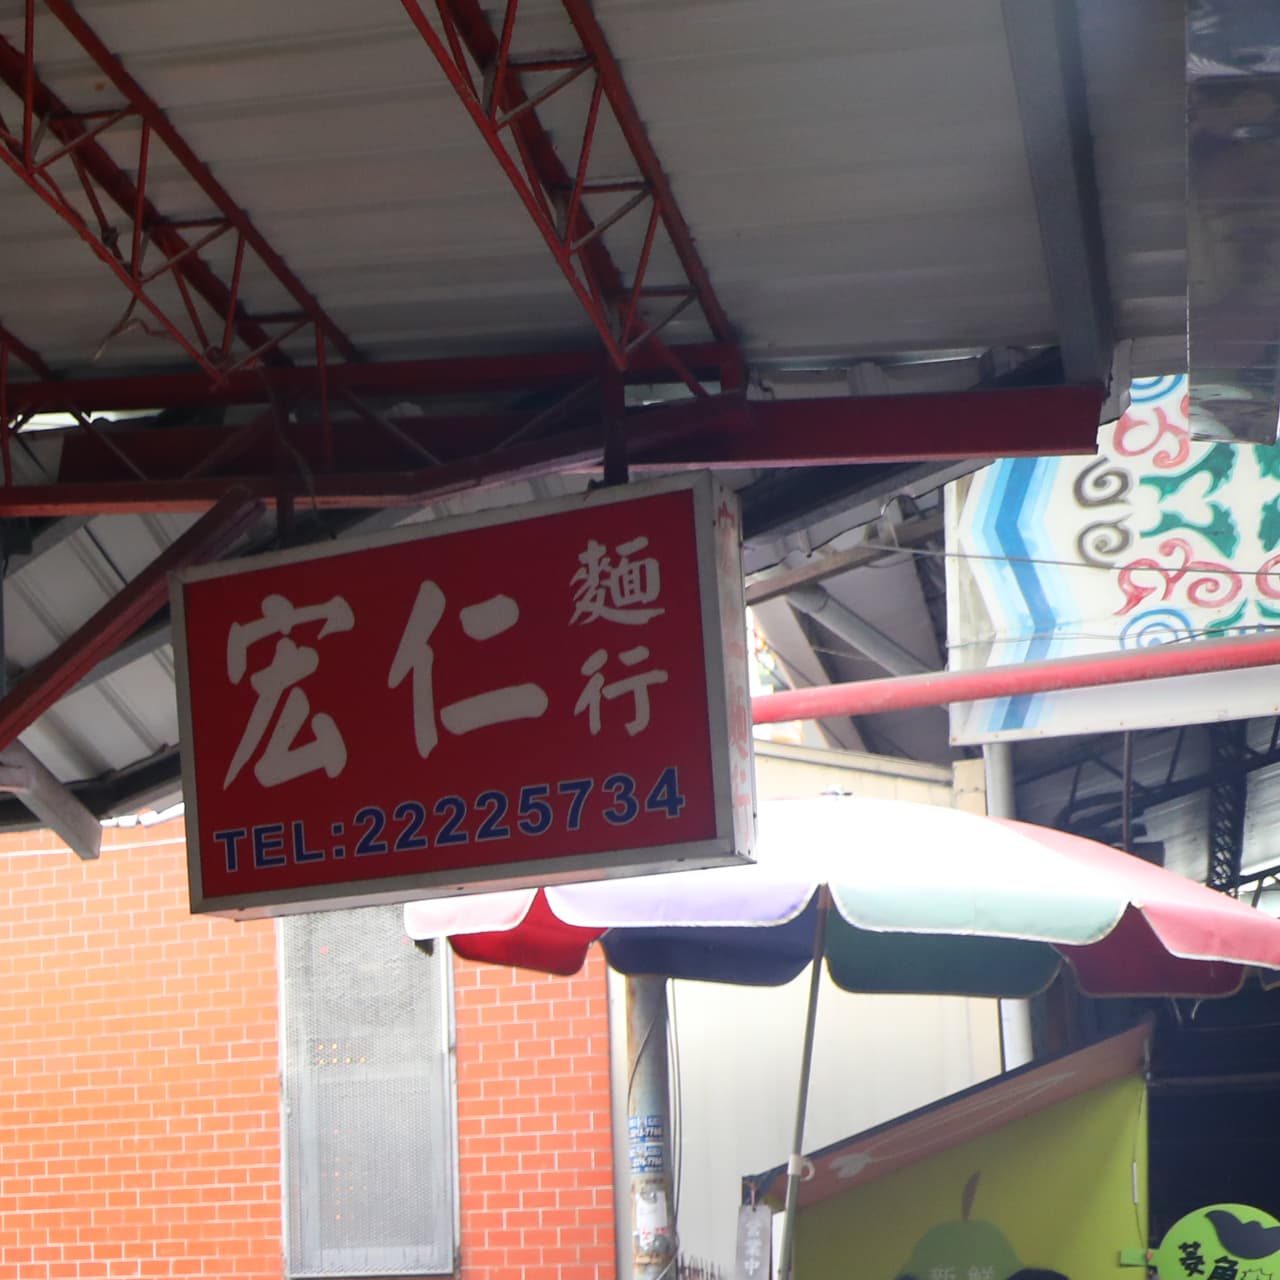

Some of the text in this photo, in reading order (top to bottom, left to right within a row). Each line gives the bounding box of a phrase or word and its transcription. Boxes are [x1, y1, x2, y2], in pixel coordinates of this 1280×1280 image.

[222, 536, 668, 791] 宏仁 麵行
[214, 767, 685, 873] TEL:22225734
